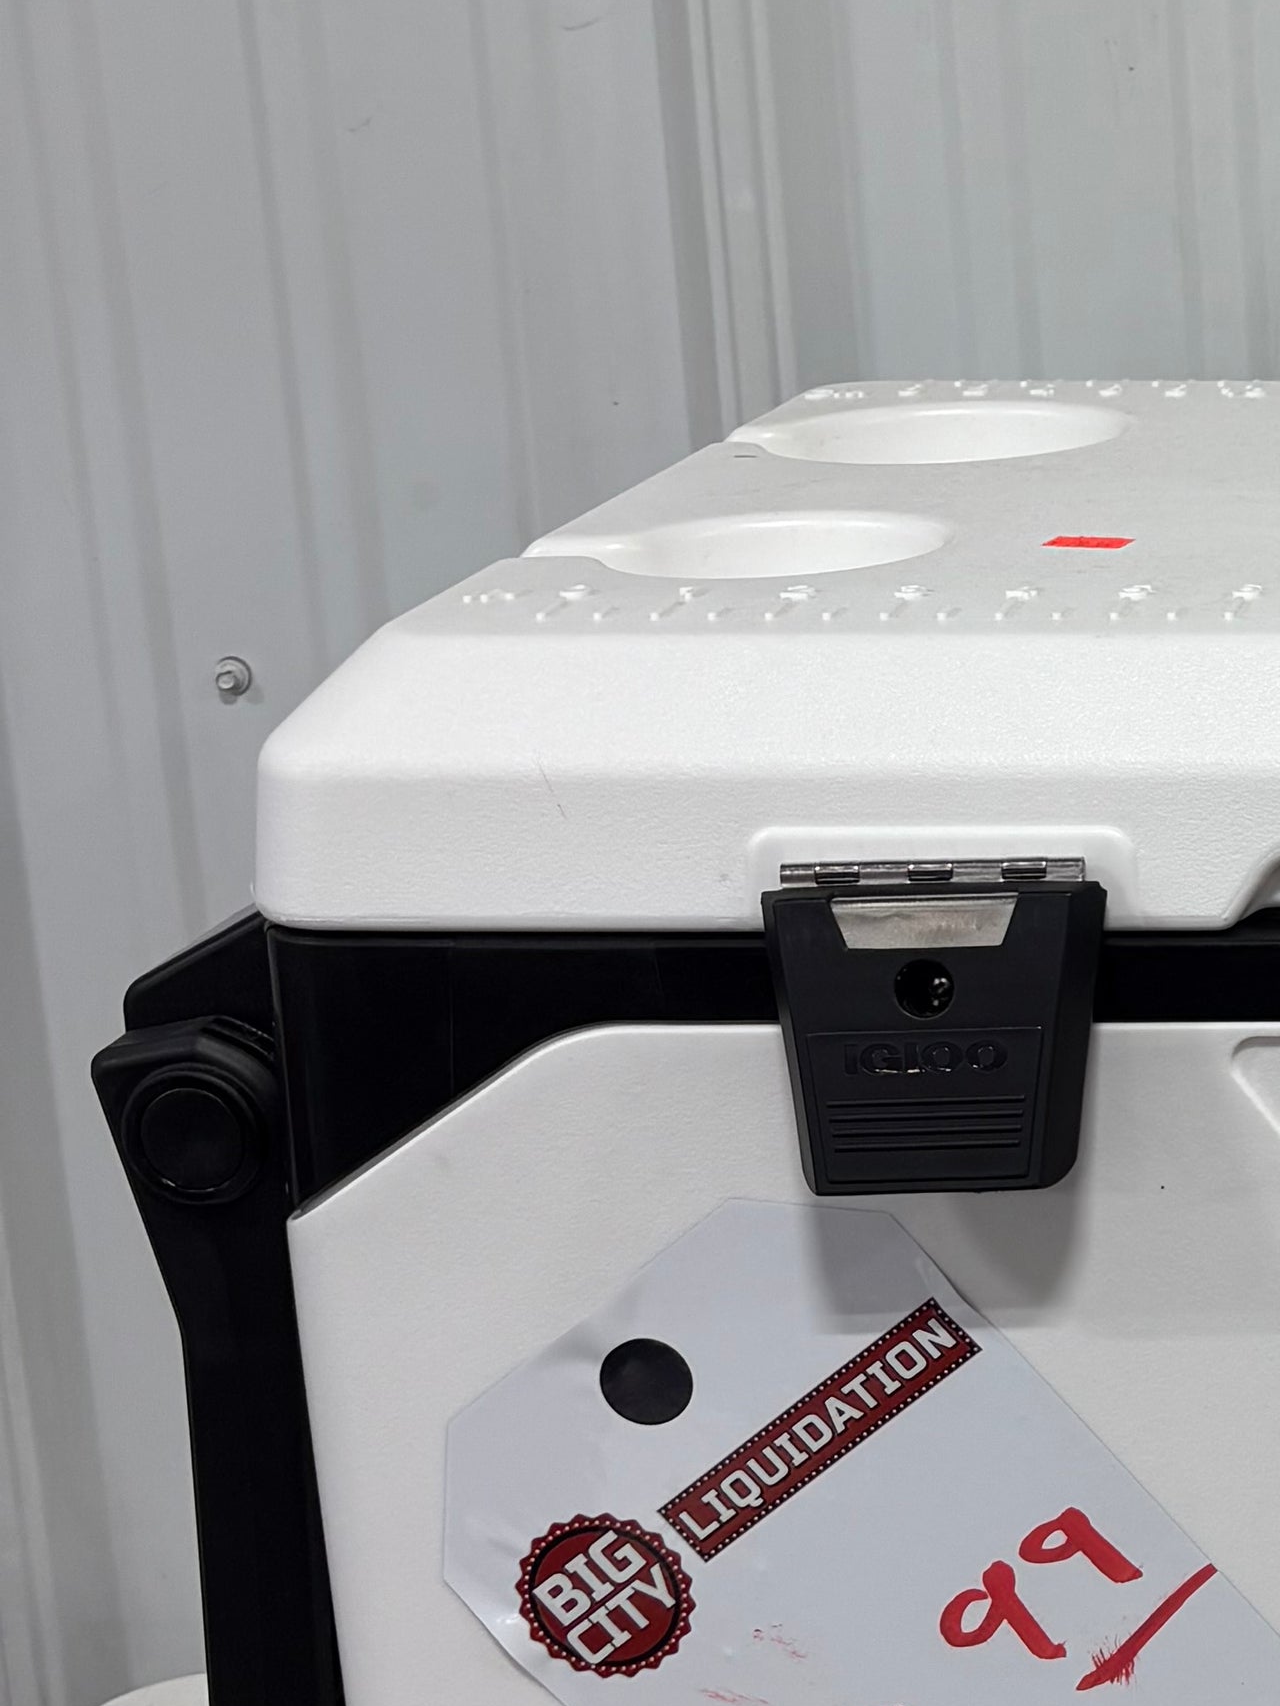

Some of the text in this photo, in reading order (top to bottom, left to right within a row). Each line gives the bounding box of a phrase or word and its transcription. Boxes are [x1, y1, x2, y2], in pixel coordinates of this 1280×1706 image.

[677, 1315, 958, 1546] LIQUIDATION
[531, 1530, 645, 1630] BIG
[566, 1562, 679, 1669] CITY
